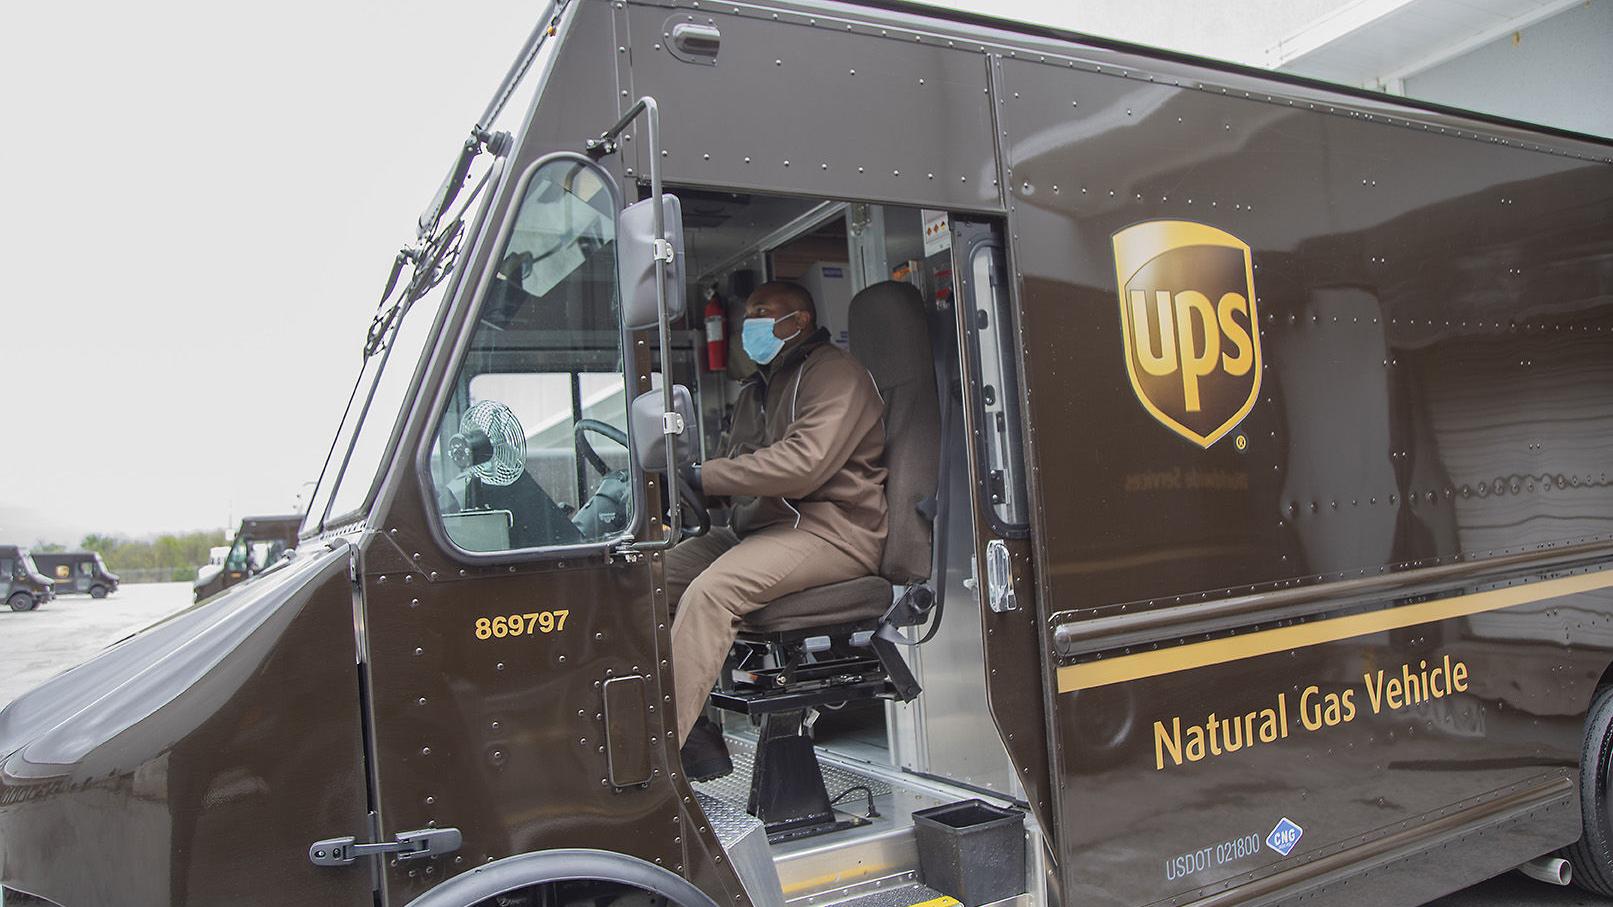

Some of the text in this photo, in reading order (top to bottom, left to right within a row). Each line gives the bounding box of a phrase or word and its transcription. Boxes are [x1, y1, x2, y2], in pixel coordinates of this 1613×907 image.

[1130, 290, 1254, 412] ups
[476, 610, 569, 639] 869797
[1154, 655, 1468, 769] Natural Gas Vehicle
[1166, 833, 1260, 881] USDOT 021800
[1273, 828, 1296, 846] CNG
